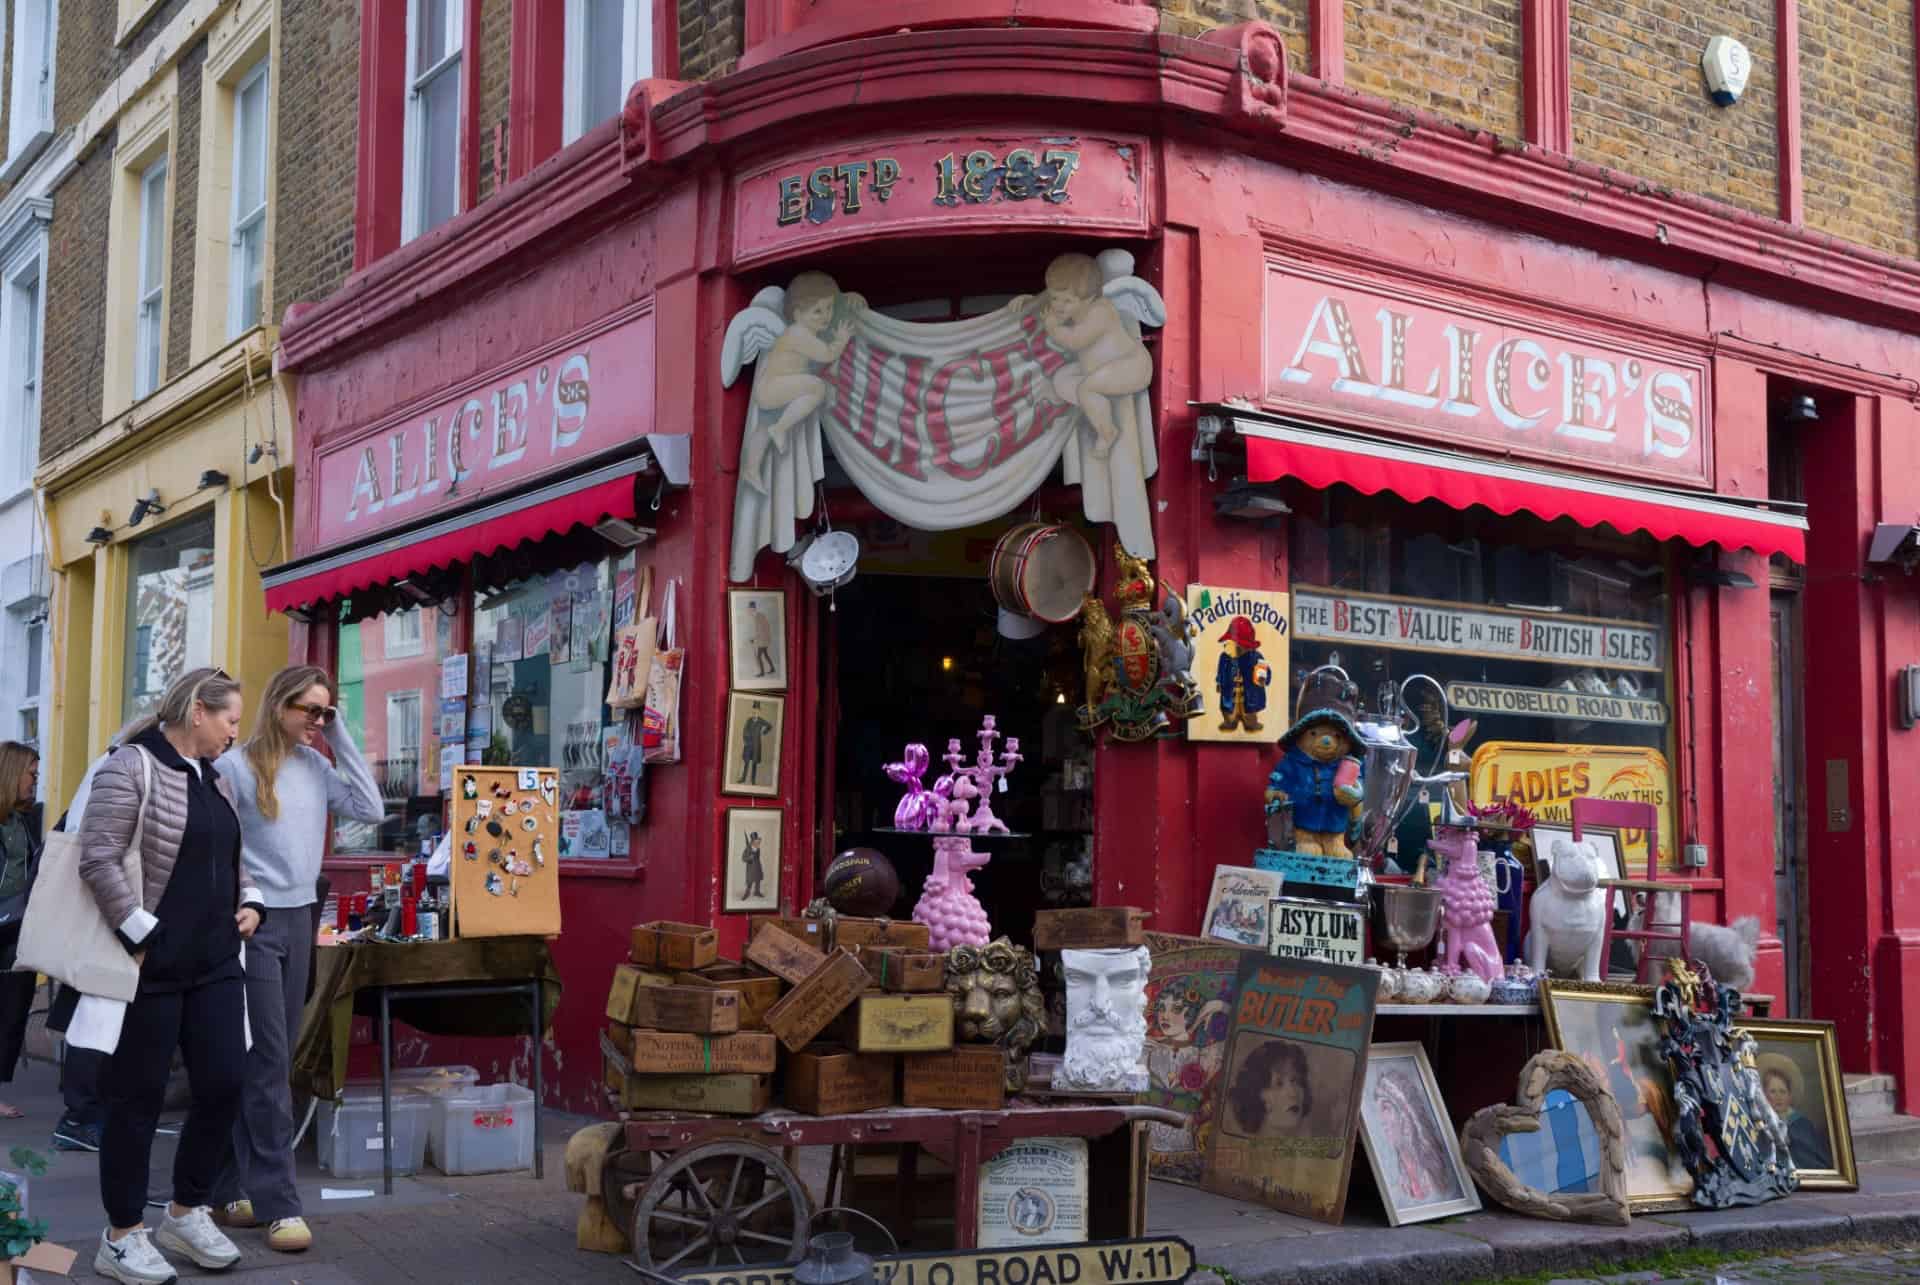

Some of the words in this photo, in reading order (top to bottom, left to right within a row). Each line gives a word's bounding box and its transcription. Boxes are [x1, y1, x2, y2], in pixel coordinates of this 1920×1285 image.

[932, 148, 1081, 207] 1887
[1281, 296, 1694, 458] ALICE'S
[344, 345, 591, 522] ALICE'S
[1191, 591, 1288, 635] Paddington
[1299, 606, 1328, 626] THE
[1333, 600, 1389, 636] BEST
[1398, 607, 1463, 643] VALUE
[1470, 624, 1483, 640] IN
[1489, 624, 1515, 644] THE
[1520, 617, 1593, 656] BRITISH
[1602, 624, 1652, 661] ISLES
[1454, 687, 1568, 714] PORTOBELLO
[1576, 697, 1623, 718] ROAD
[1628, 702, 1661, 721] W.11
[1489, 762, 1590, 804] LADIES
[1632, 789, 1664, 805] THIS
[1279, 908, 1358, 940] ASYLUM
[1237, 991, 1339, 1037] BUTLER
[976, 1253, 1081, 1285] ROAD
[1098, 1246, 1172, 1281] W.11
